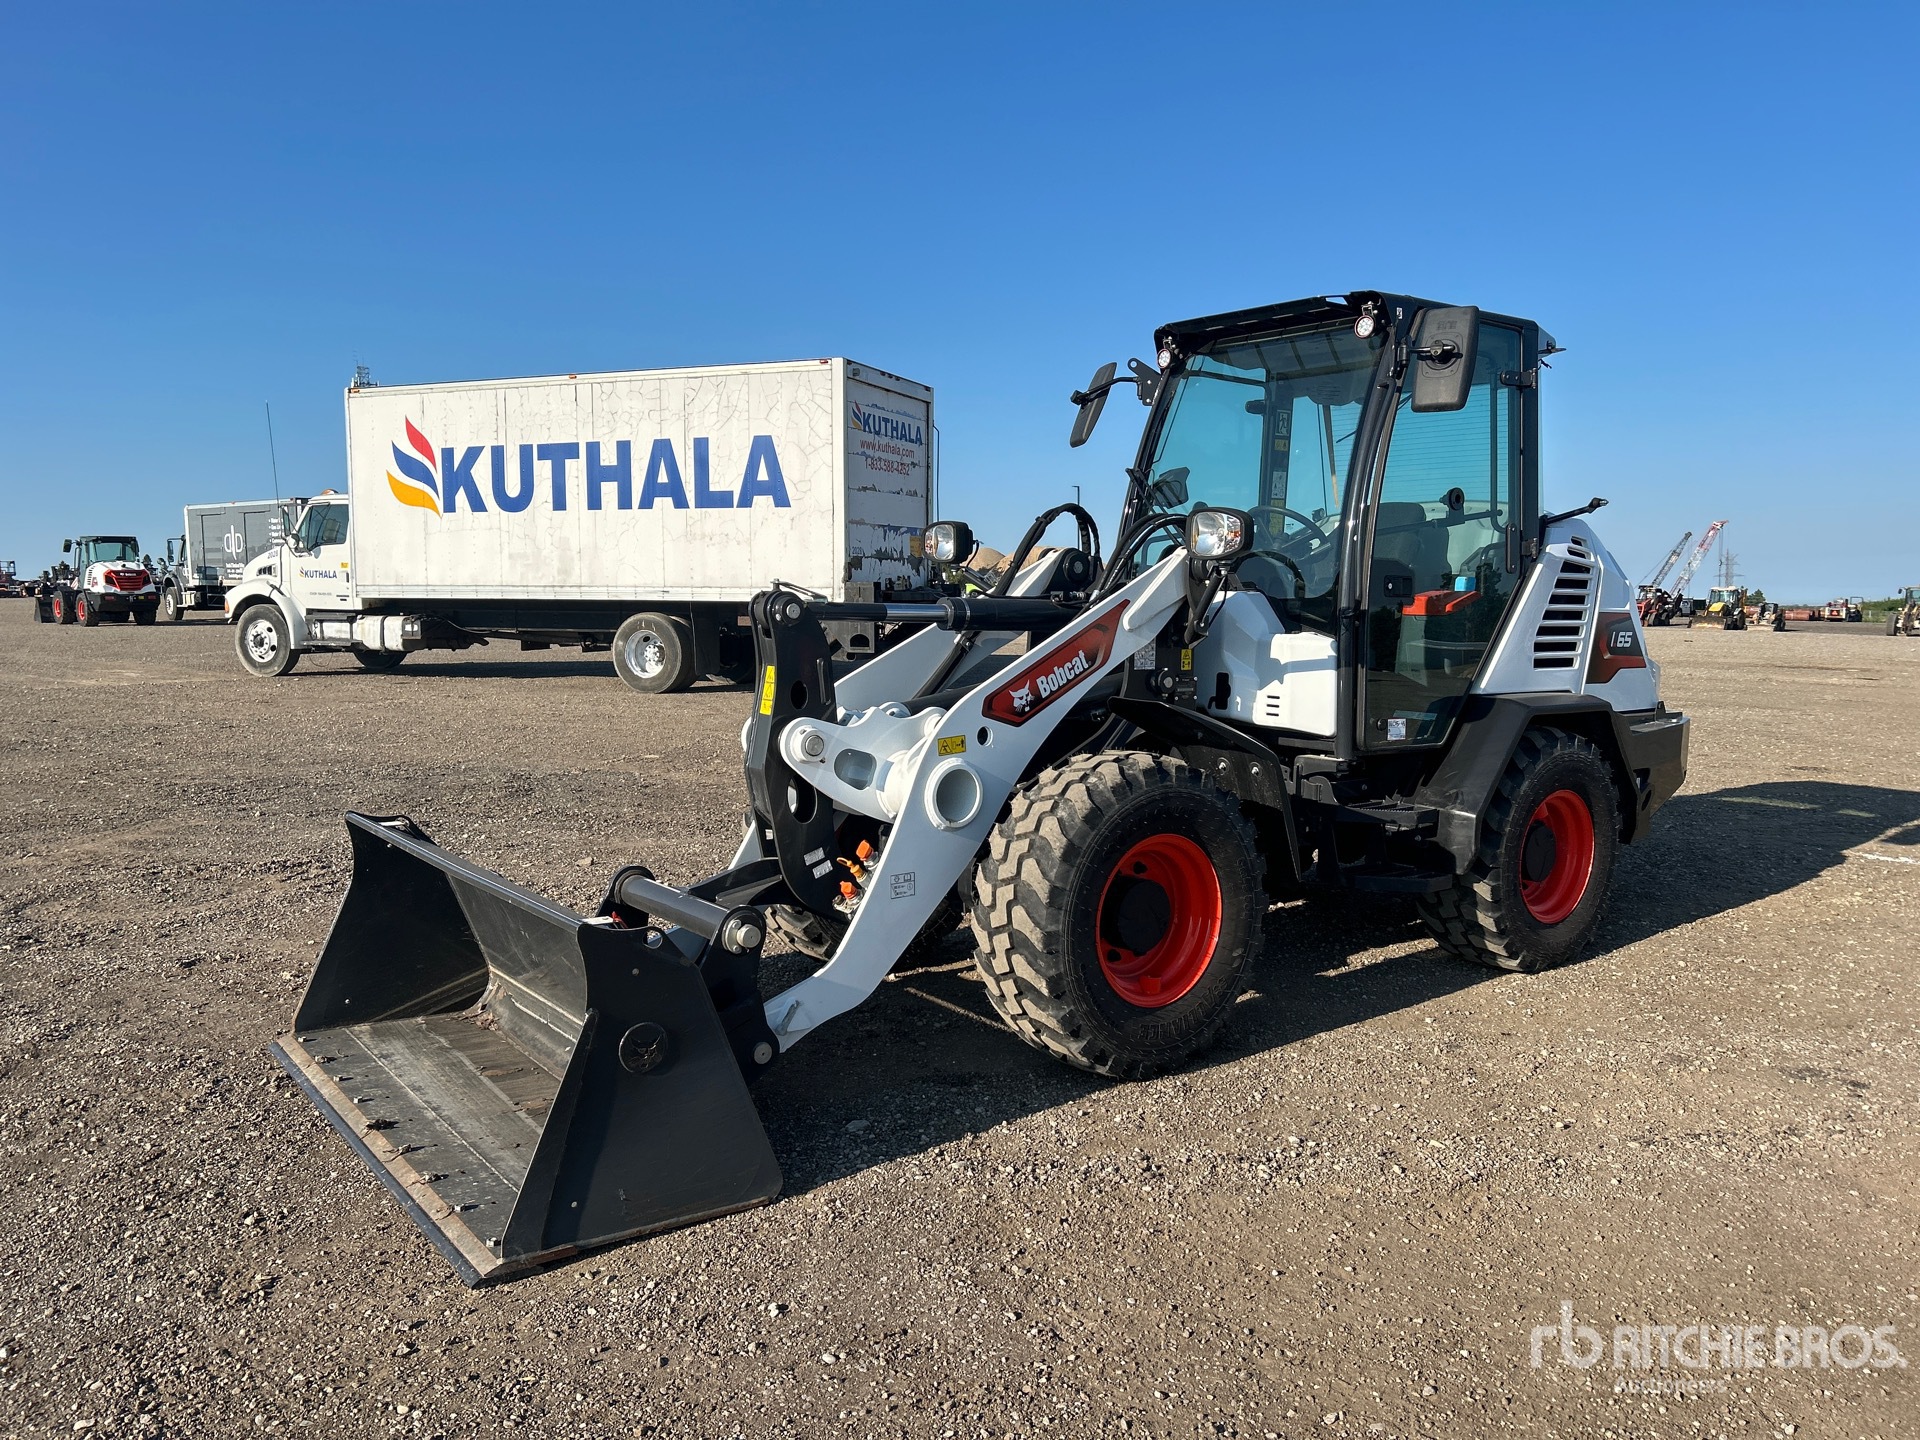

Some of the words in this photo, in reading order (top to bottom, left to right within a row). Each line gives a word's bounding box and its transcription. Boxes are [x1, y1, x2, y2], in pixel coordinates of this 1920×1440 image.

[862, 412, 923, 445] KUTHALA
[860, 440, 914, 459] www.kuthala.com
[441, 434, 792, 514] KUTHALA
[304, 570, 338, 579] KUTHALA
[1036, 649, 1089, 699] Bobcat
